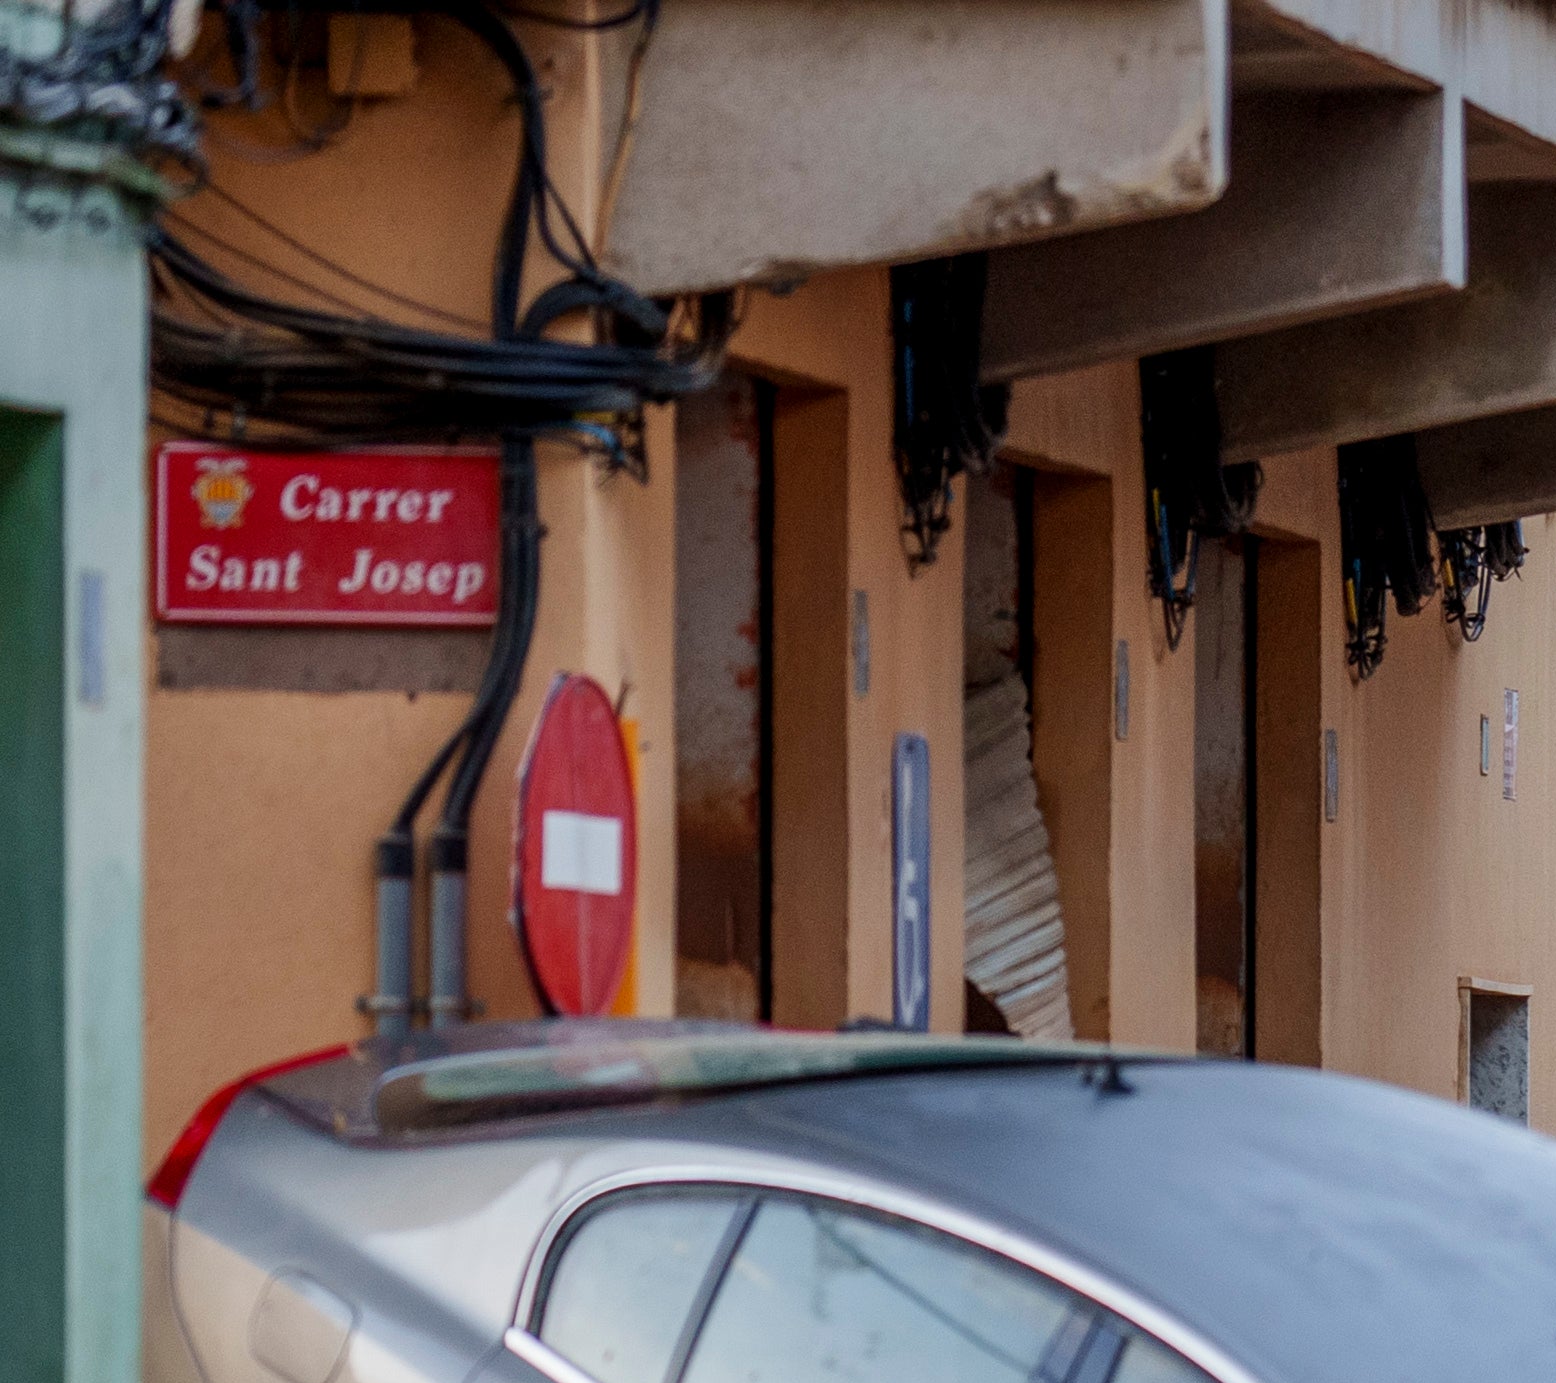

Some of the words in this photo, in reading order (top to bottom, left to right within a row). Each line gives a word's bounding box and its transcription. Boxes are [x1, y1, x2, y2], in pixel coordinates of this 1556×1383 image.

[279, 474, 453, 523] Carrer
[186, 545, 303, 592] Sant
[338, 549, 484, 604] Josep
